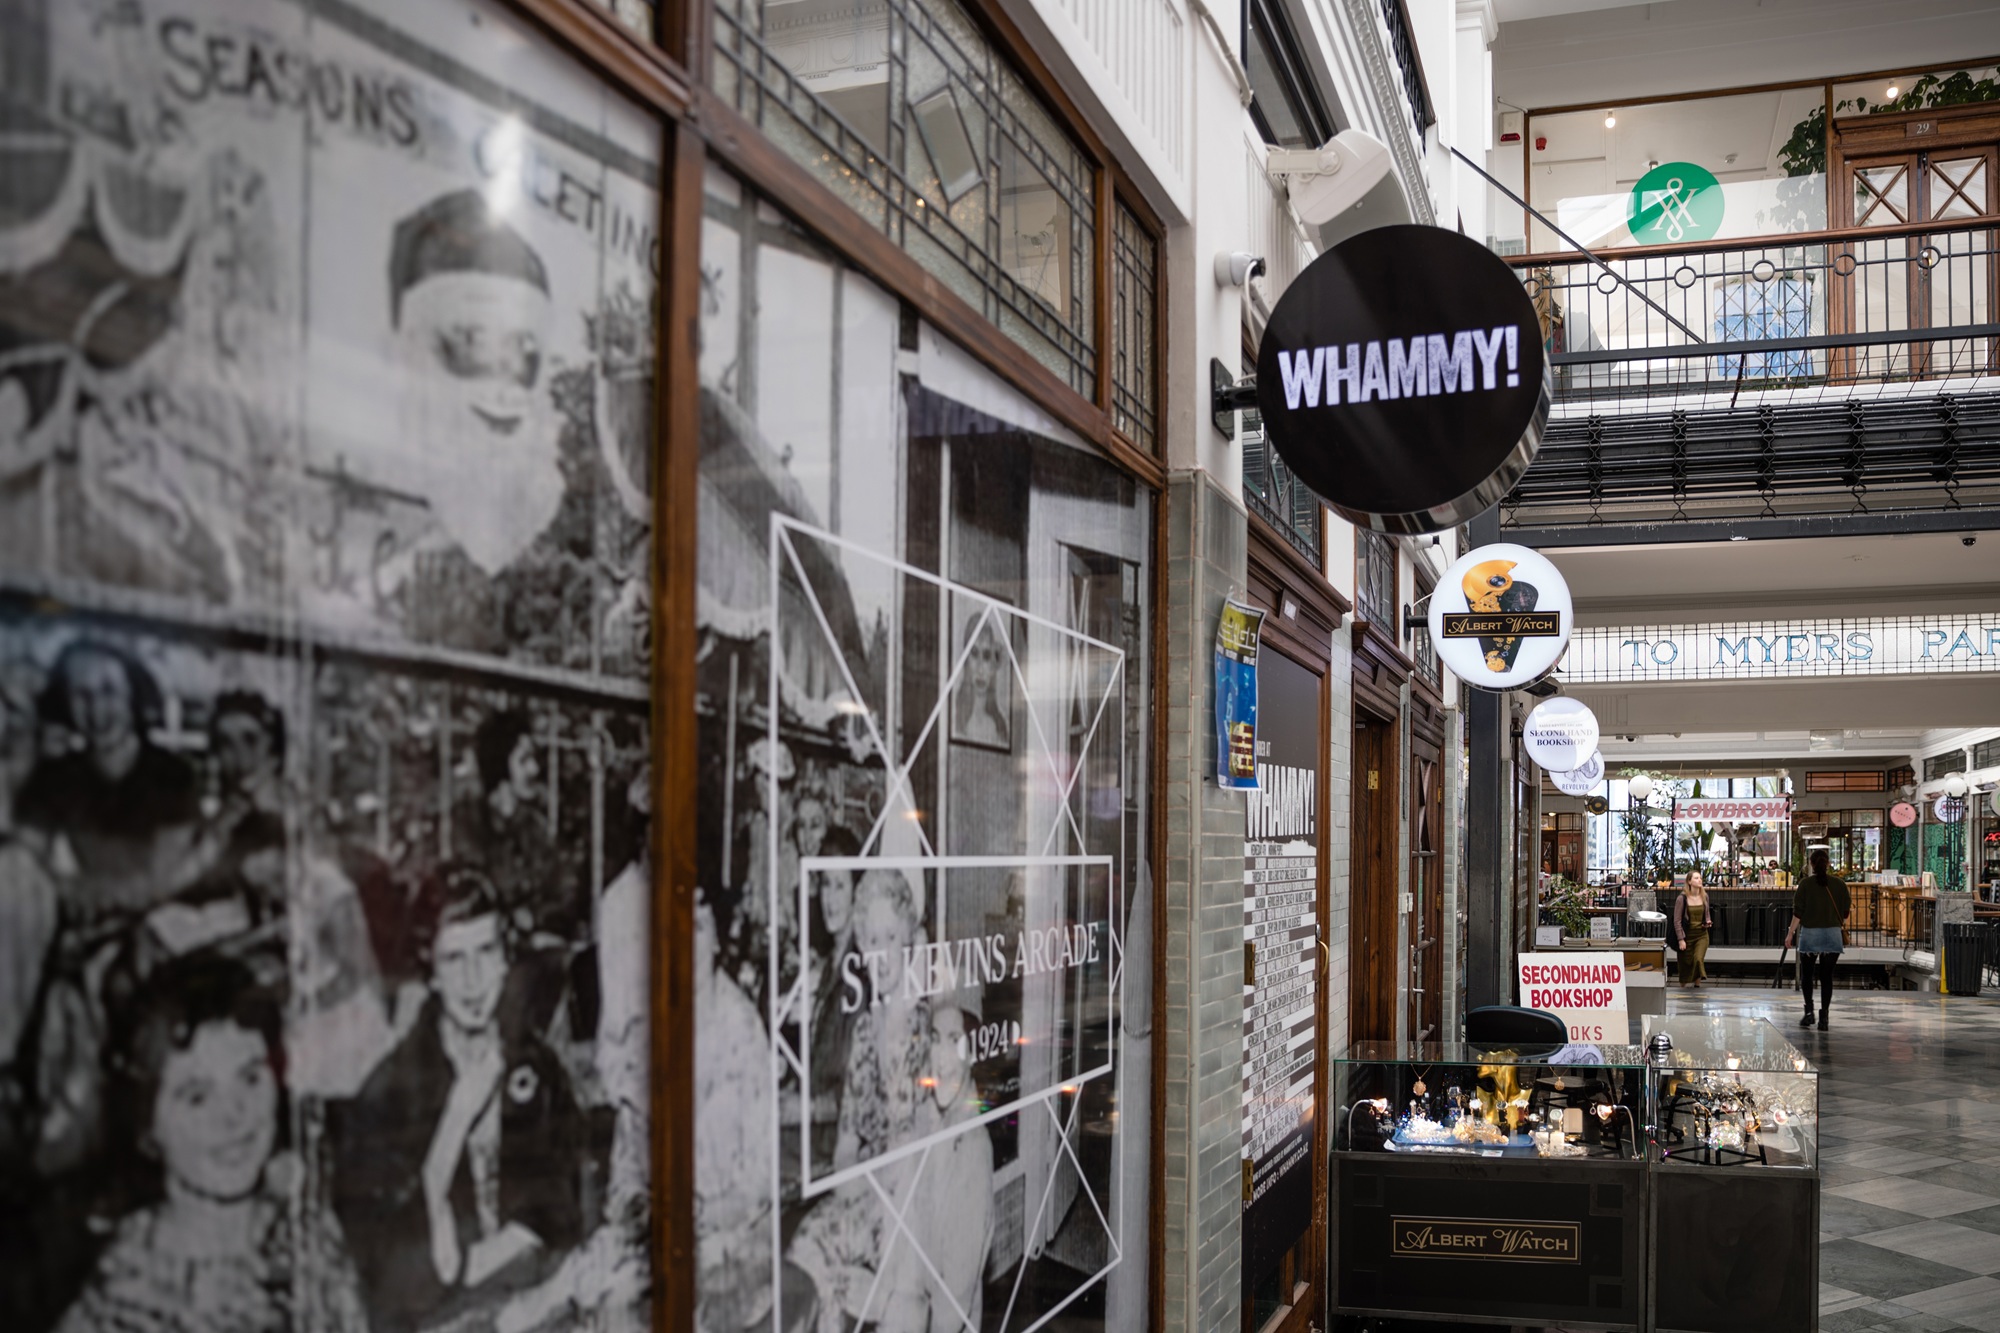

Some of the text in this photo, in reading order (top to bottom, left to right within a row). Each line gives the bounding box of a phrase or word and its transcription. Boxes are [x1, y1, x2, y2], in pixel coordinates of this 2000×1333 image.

[1916, 122, 1930, 134] 29
[1278, 325, 1519, 410] WHAMMY!
[1448, 616, 1553, 634] ALBERT WATCH
[1620, 638, 1679, 669] TO
[1714, 630, 1875, 667] MYERS
[1529, 729, 1565, 737] SECOND
[1246, 762, 1315, 839] WHAMMY!
[841, 921, 1100, 1015] ST. KEVINS ARCADE
[1521, 964, 1622, 984] SECONDHAND
[1530, 988, 1613, 1008] BOOKSHOP
[969, 1019, 1009, 1065] 1924
[1570, 1025, 1603, 1041] OKS
[1400, 1226, 1569, 1253] ALBERT WATCH
